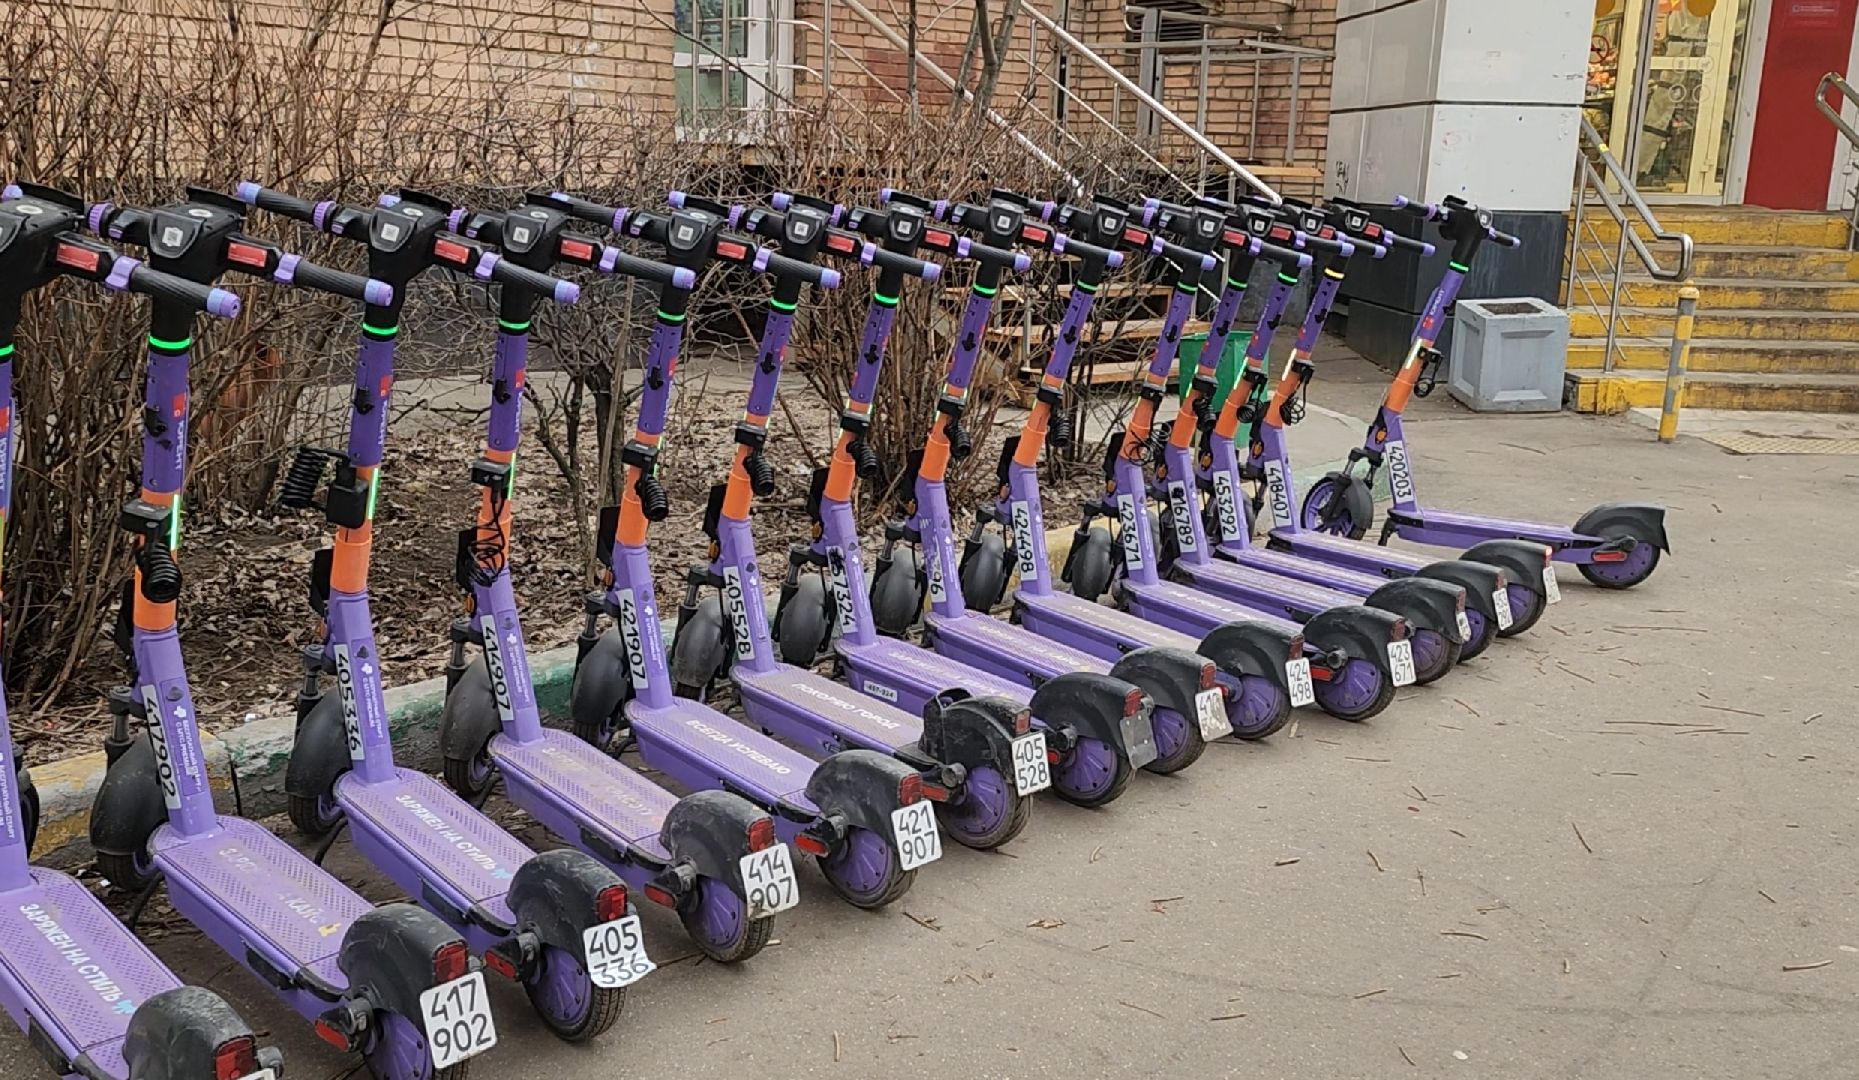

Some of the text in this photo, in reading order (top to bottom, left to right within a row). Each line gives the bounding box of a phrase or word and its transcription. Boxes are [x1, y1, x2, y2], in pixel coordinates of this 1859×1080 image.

[1266, 467, 1290, 521] 418407
[1390, 446, 1411, 498] 420203
[1171, 487, 1195, 547] 16789
[1215, 475, 1237, 535] 453292
[1014, 507, 1035, 573] 424498
[1120, 501, 1142, 563] 423671
[829, 547, 856, 626] 57324
[623, 598, 646, 680] 421907
[726, 574, 752, 655] 405528
[485, 626, 511, 711] 414907
[1290, 661, 1309, 682] 424
[1391, 643, 1409, 662] 423
[1395, 662, 1414, 682] 671
[338, 653, 361, 751] 405336
[792, 683, 901, 729] ПОКОРЯЮ ГОРОД
[1292, 681, 1311, 702] 498
[147, 698, 176, 797] 417902
[685, 719, 791, 774] ВСЕГДА УСПЕВАЮ
[1016, 737, 1043, 764] 405
[1018, 761, 1047, 790] 528
[396, 795, 498, 870] ЗАРЯЖЕН НА СТИЛЬ
[899, 804, 931, 836] 421
[749, 849, 787, 883] 414
[902, 830, 935, 864] 907
[750, 876, 792, 911] 907
[20, 903, 125, 1002] ЗАРЯЖЕН НА СТИЛЬ
[589, 920, 638, 959] 405
[593, 952, 649, 984] 336
[431, 978, 477, 1021] 417
[433, 1013, 492, 1062] 902
